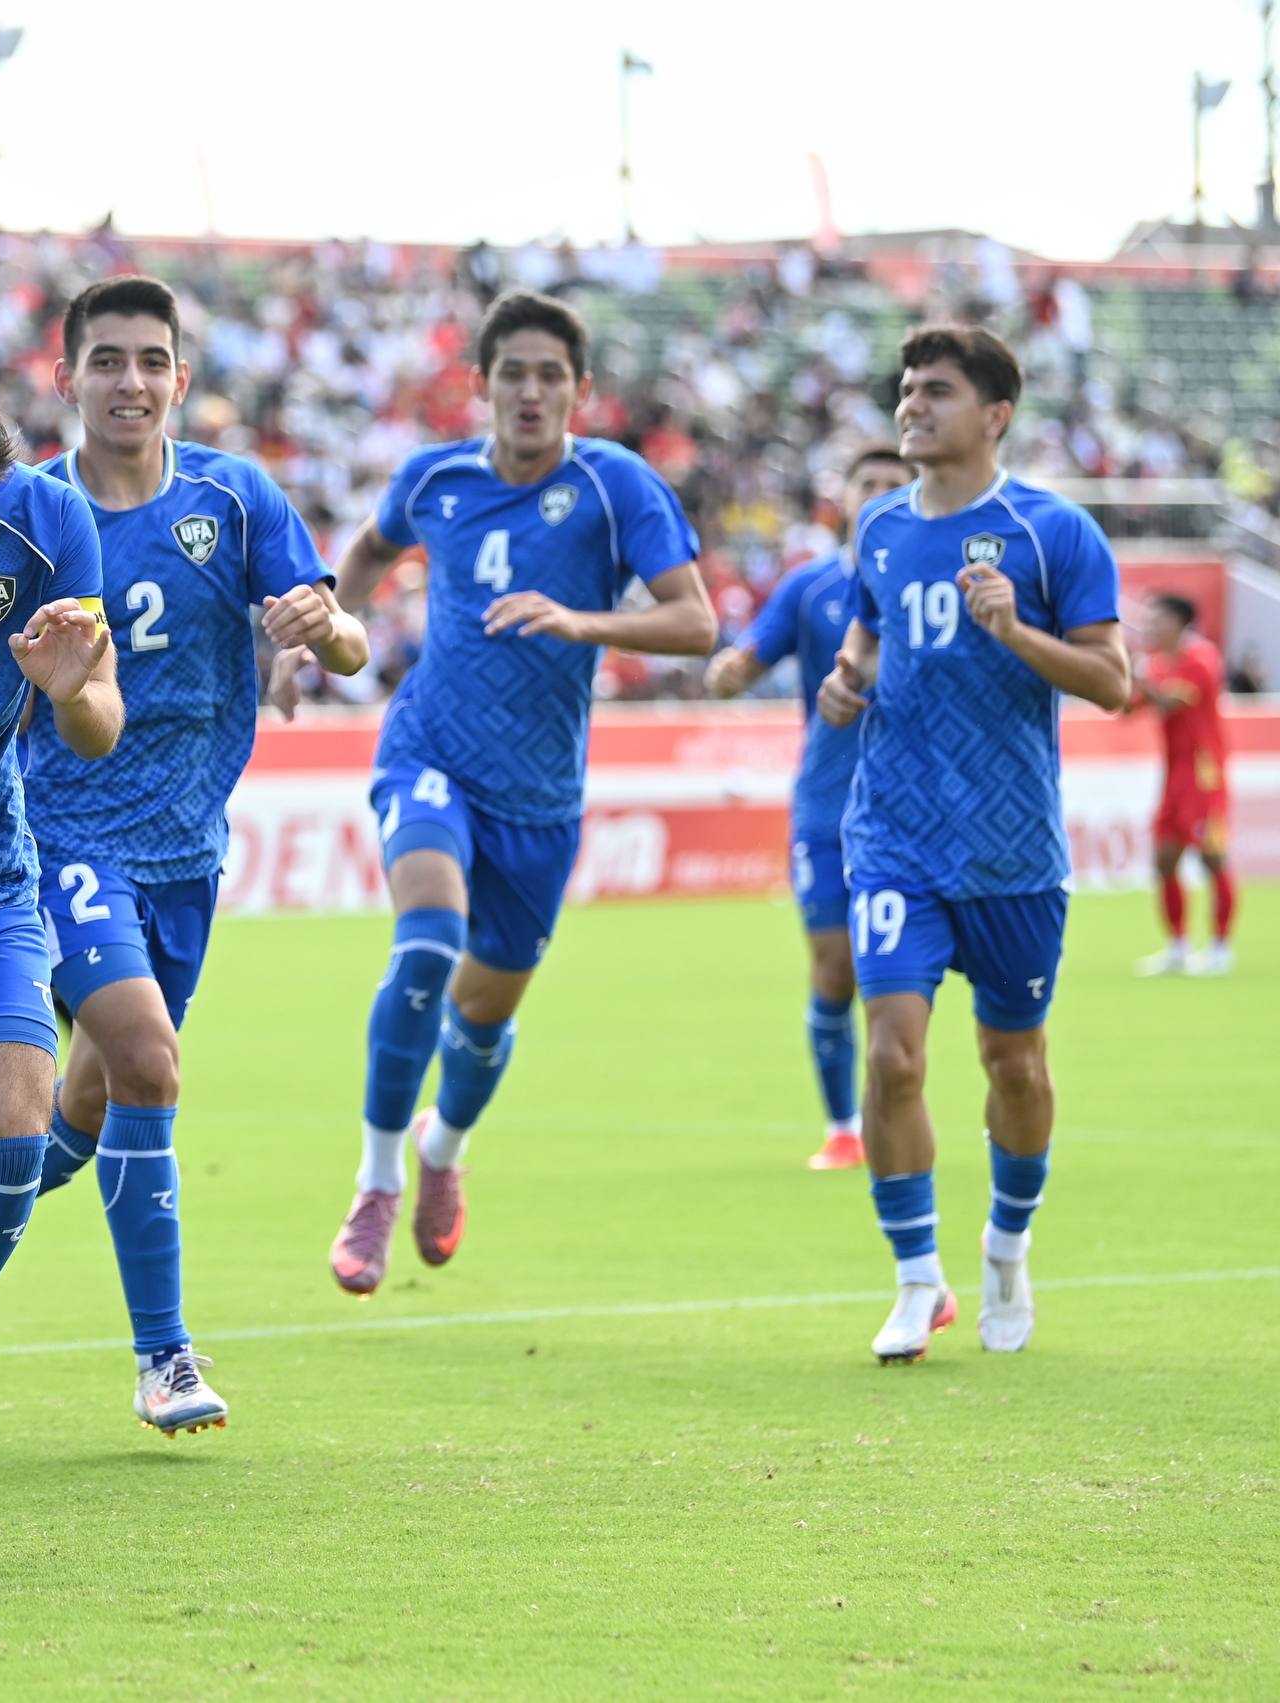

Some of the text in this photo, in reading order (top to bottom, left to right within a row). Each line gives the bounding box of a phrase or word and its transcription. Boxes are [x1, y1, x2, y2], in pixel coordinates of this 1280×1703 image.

[179, 521, 214, 544] UFA
[473, 529, 512, 593] 4
[126, 580, 169, 652] 2
[900, 580, 959, 649] 19
[411, 767, 451, 809] 4
[59, 863, 112, 925] 2
[854, 889, 907, 957] 19
